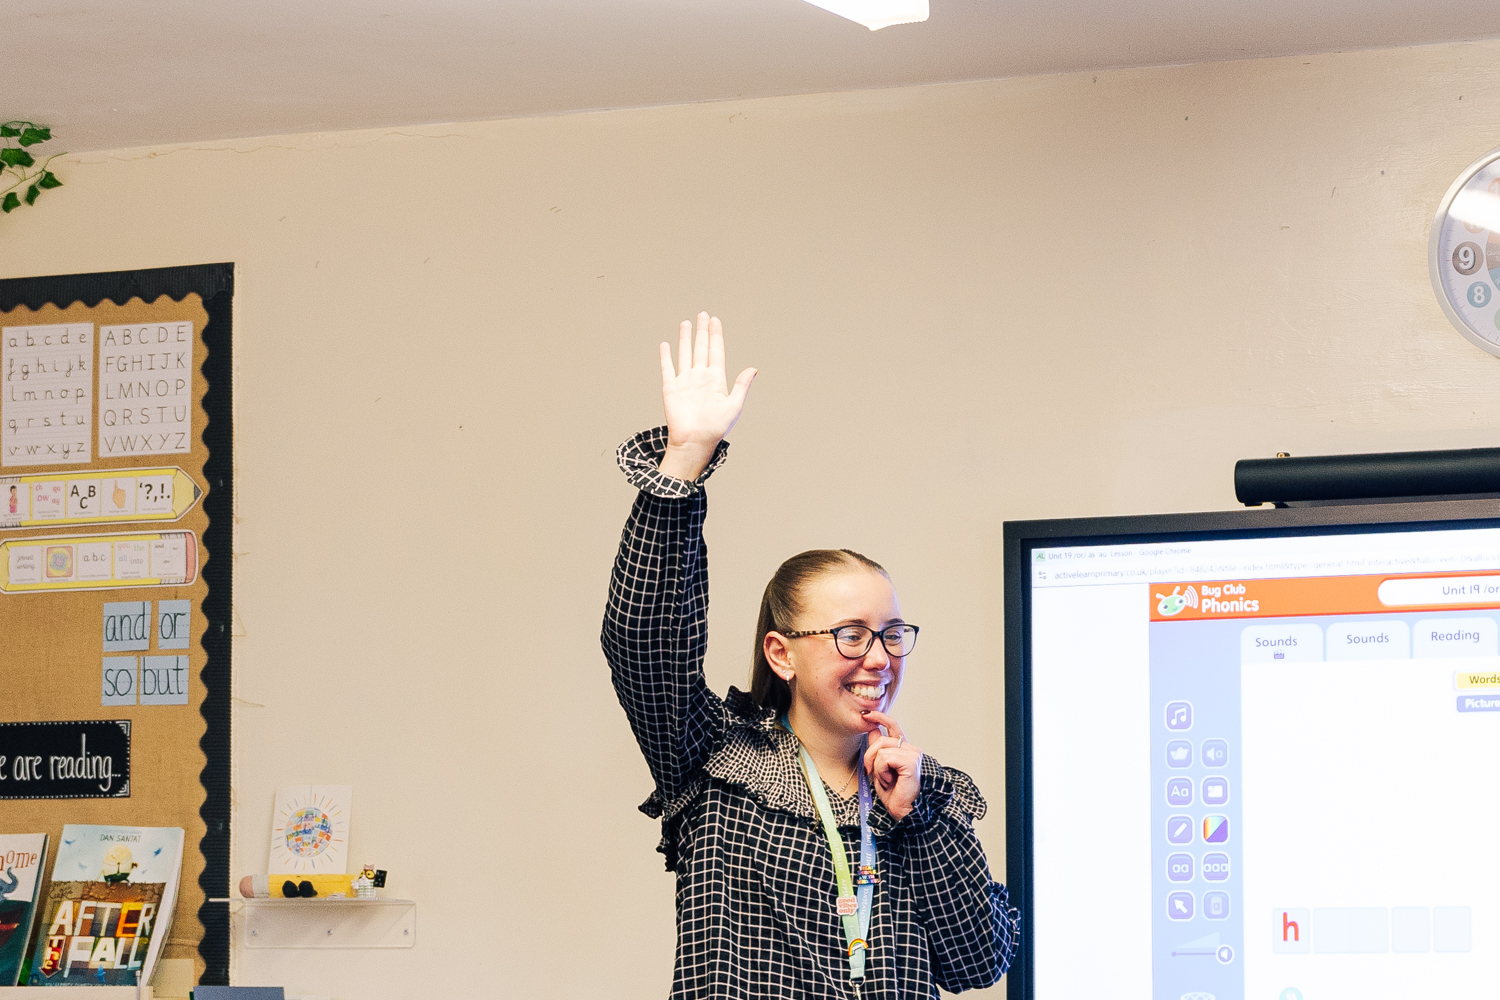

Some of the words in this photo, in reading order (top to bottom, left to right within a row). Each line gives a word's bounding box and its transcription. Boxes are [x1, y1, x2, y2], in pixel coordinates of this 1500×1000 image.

[1458, 245, 1477, 270] 9
[1473, 285, 1485, 304] 8
[70, 485, 80, 498] A
[88, 485, 96, 498] B
[79, 497, 88, 509] C
[1139, 548, 1164, 557] Google
[1165, 547, 1192, 555] Chrome
[1201, 585, 1221, 598] Bug
[1223, 583, 1246, 595] Club
[1442, 584, 1465, 595] Unit
[1469, 584, 1480, 594] 19
[1201, 597, 1260, 613] Phonics
[105, 601, 147, 642] and
[161, 612, 187, 640] or
[1255, 636, 1298, 647] Sounds
[1346, 633, 1390, 644] Sounds
[1431, 629, 1480, 643] Reading
[104, 668, 133, 696] so
[143, 655, 184, 696] but
[14, 755, 43, 781] are
[1171, 785, 1189, 797] Aa
[100, 833, 115, 843] DAN
[116, 834, 142, 844] SANTAT
[50, 899, 157, 937] AFTER
[1282, 912, 1299, 942] h
[63, 935, 144, 979] FALL
